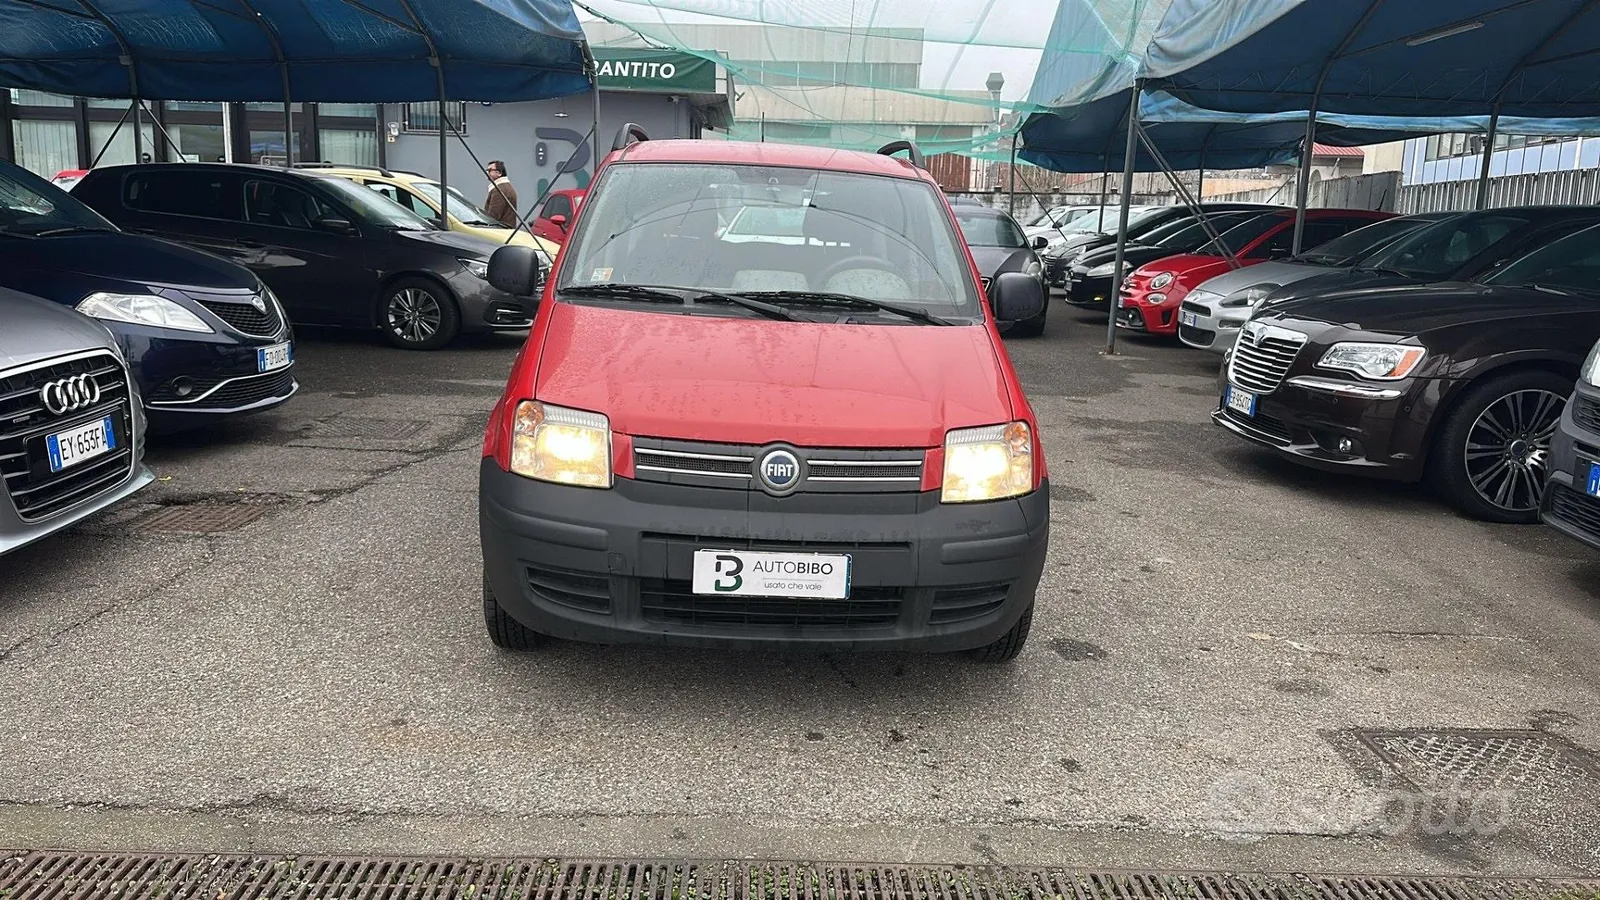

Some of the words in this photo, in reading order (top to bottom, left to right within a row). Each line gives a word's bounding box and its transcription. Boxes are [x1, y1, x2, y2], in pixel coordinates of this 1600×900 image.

[767, 463, 794, 477] FIAT
[752, 560, 834, 576] AUTOBIBO
[764, 581, 786, 589] usato
[787, 582, 803, 590] che
[805, 583, 821, 591] vale
